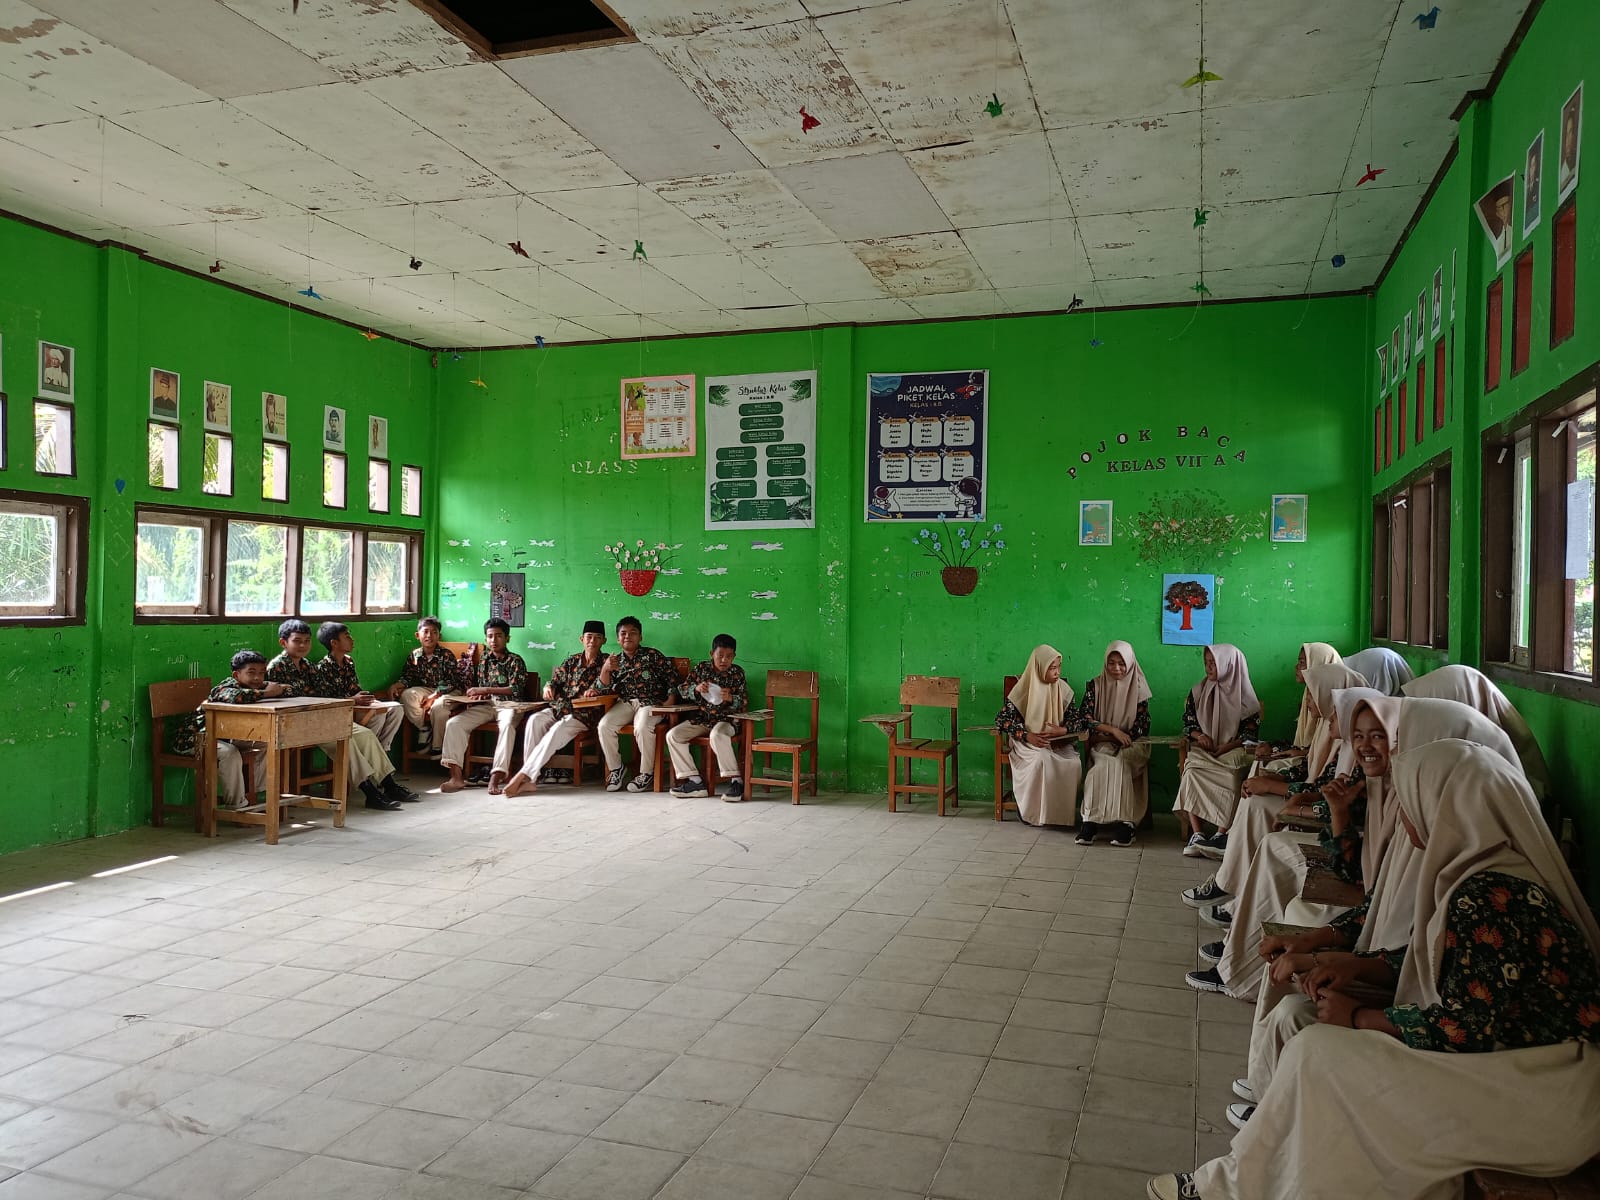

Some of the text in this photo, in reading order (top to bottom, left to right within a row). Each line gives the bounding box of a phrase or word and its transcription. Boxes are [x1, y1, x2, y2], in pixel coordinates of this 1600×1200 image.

[907, 384, 946, 393] JADWAL
[897, 392, 956, 402] PIKET KELAS
[1065, 425, 1247, 480] POJOK BACA
[1106, 456, 1167, 474] KELAS
[1213, 454, 1226, 466] A
